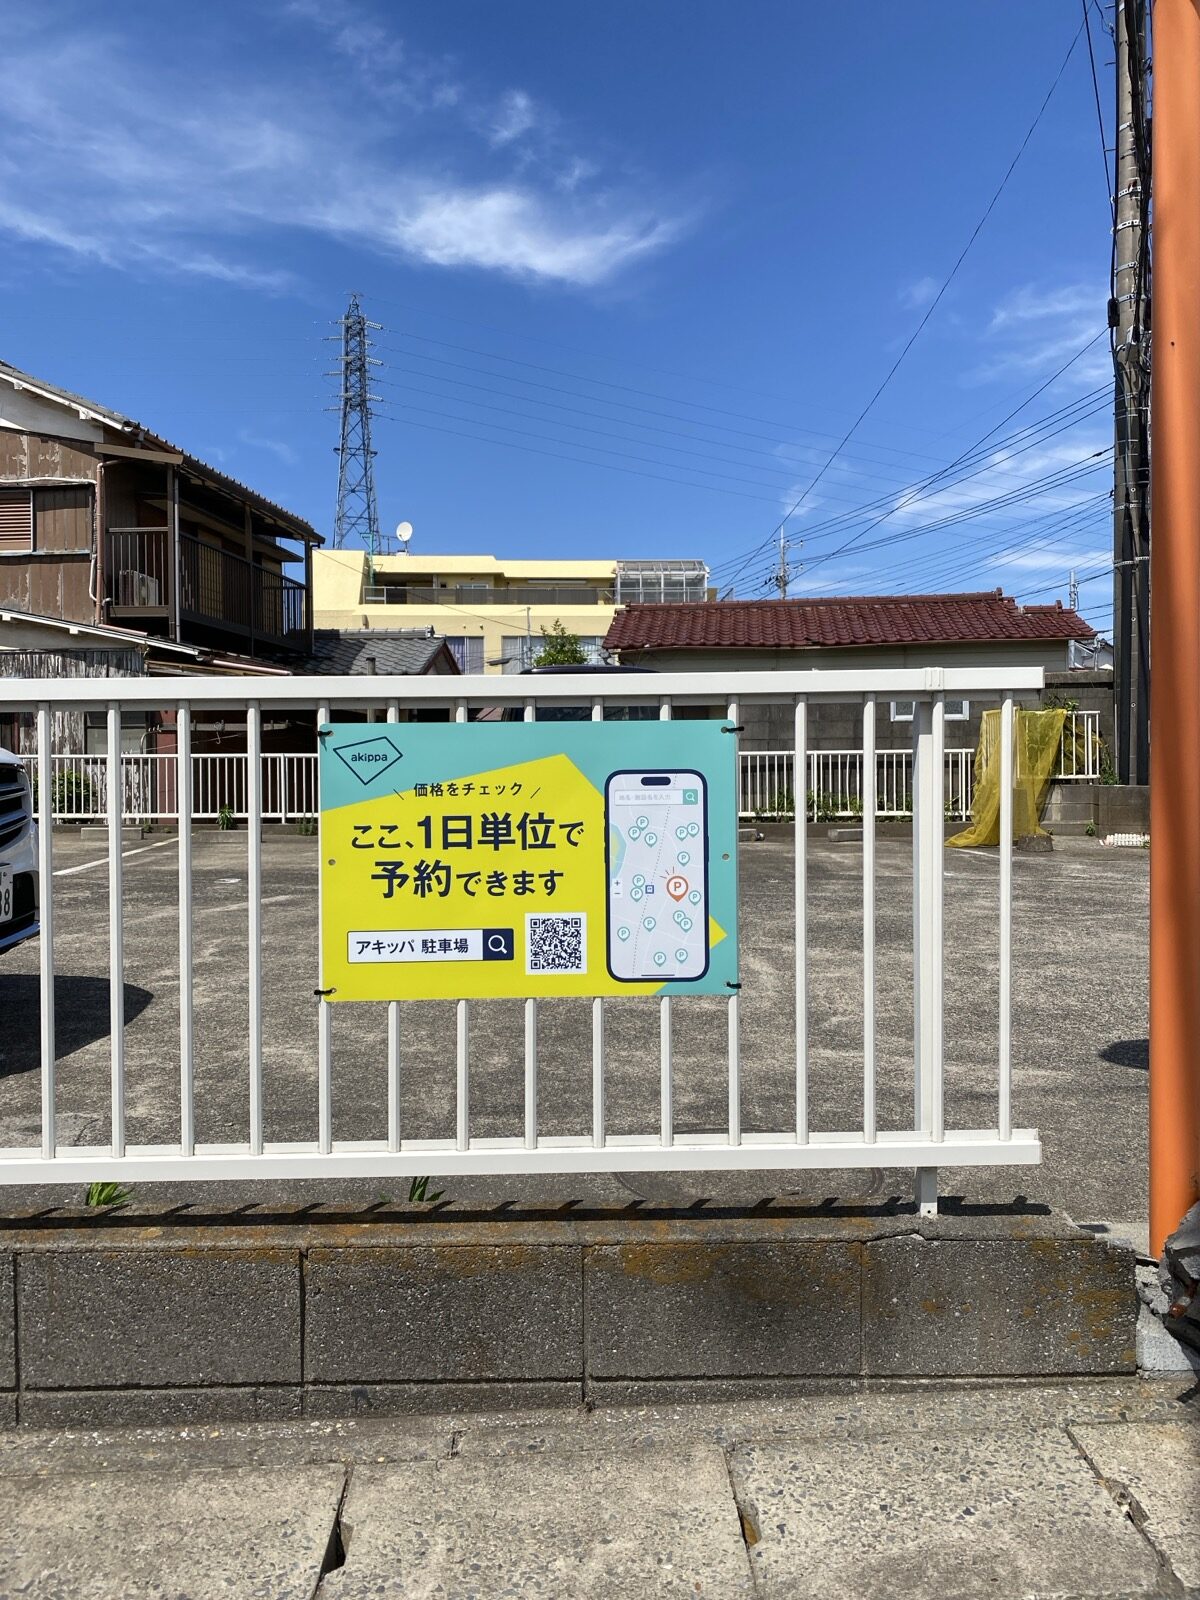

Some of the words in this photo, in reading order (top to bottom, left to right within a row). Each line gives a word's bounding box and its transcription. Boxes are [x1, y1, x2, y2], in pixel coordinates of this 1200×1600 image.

[351, 752, 388, 763] akippa
[413, 782, 524, 797] 価格をチェック
[351, 811, 585, 852] ここ、1日単位で
[370, 859, 564, 899] 予約できます
[355, 938, 415, 955] アキッパ
[421, 938, 469, 954] 駐車場
